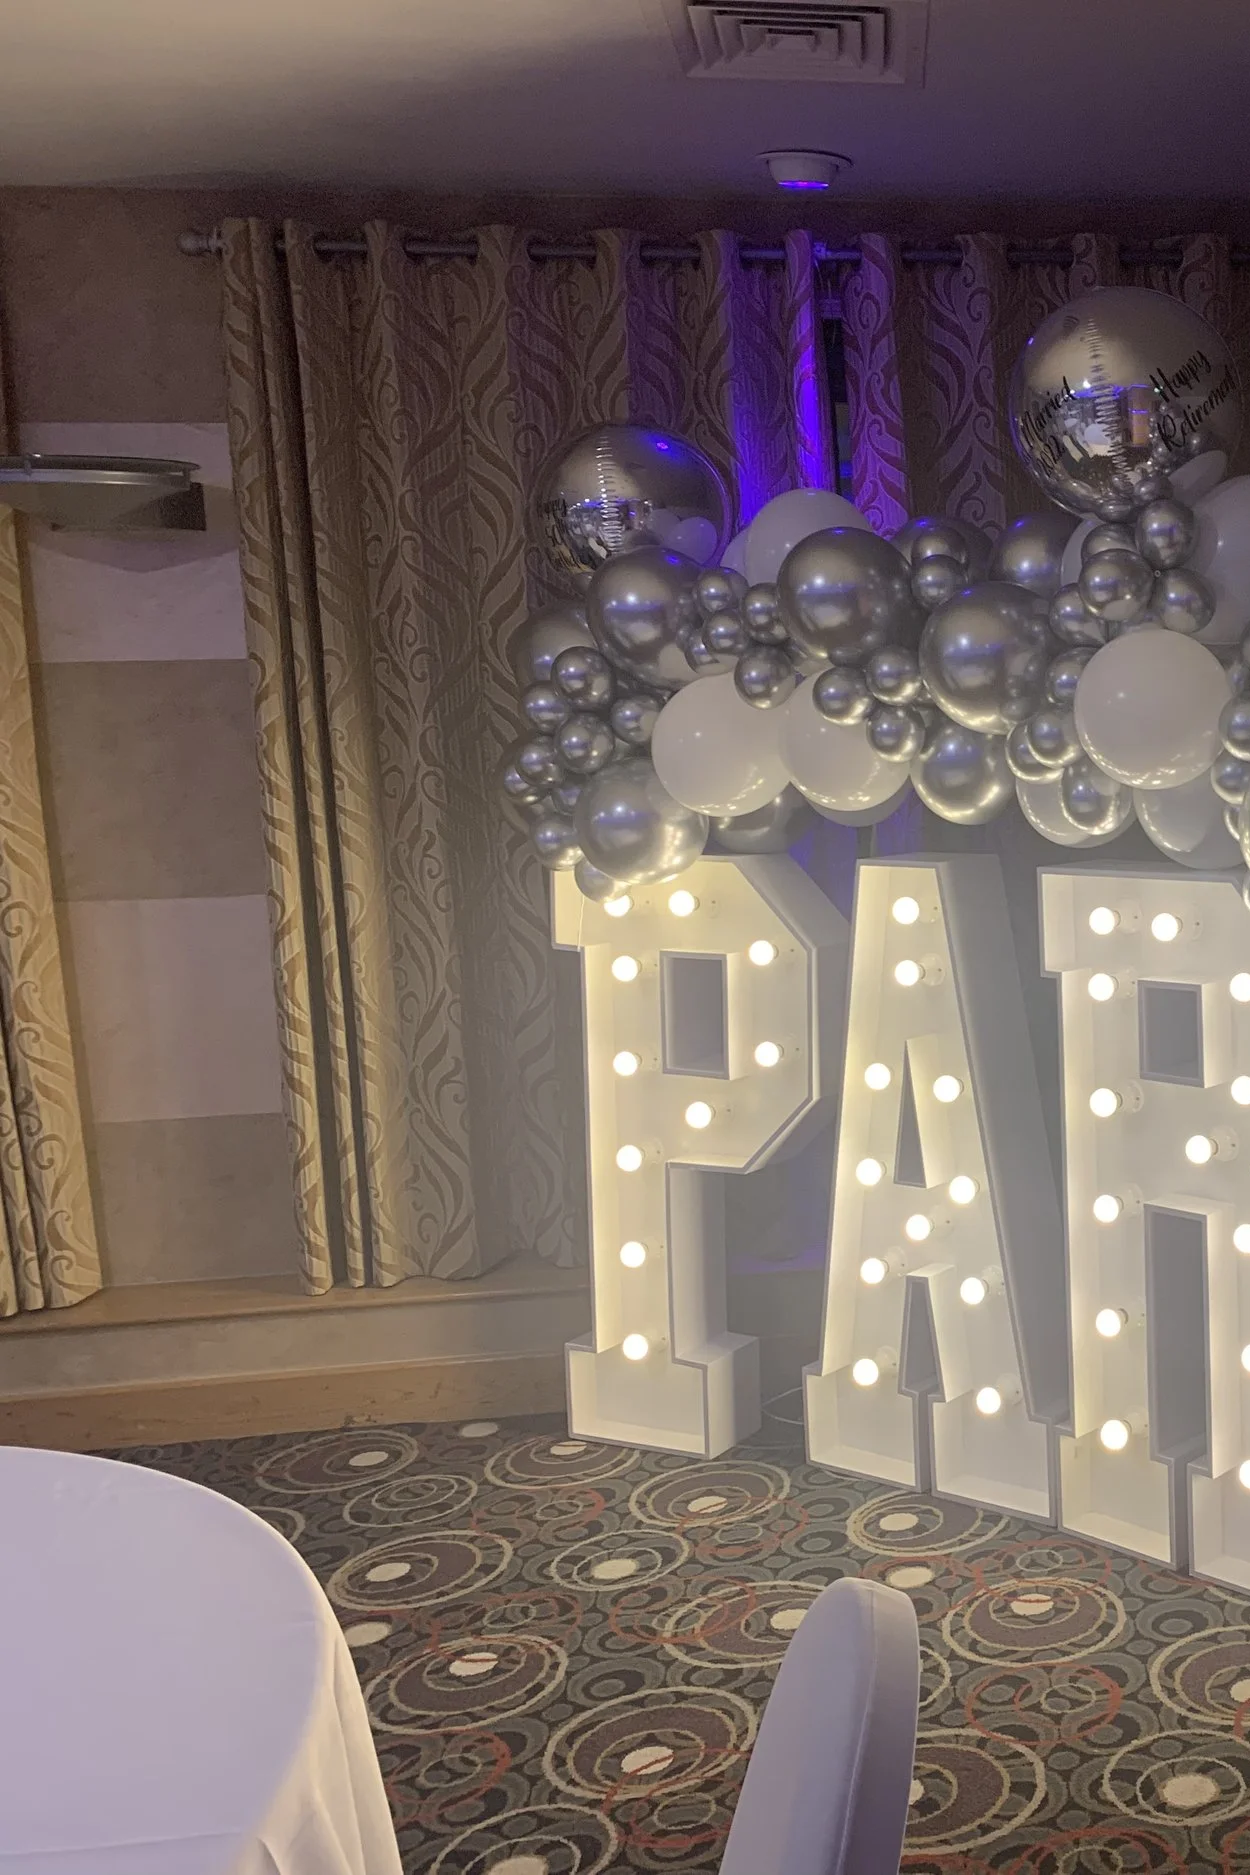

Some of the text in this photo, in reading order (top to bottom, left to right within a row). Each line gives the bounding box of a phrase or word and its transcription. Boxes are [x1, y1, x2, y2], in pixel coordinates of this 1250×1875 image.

[1021, 375, 1078, 449] Married
[1149, 349, 1212, 404] Happy
[1157, 364, 1236, 452] Retirement
